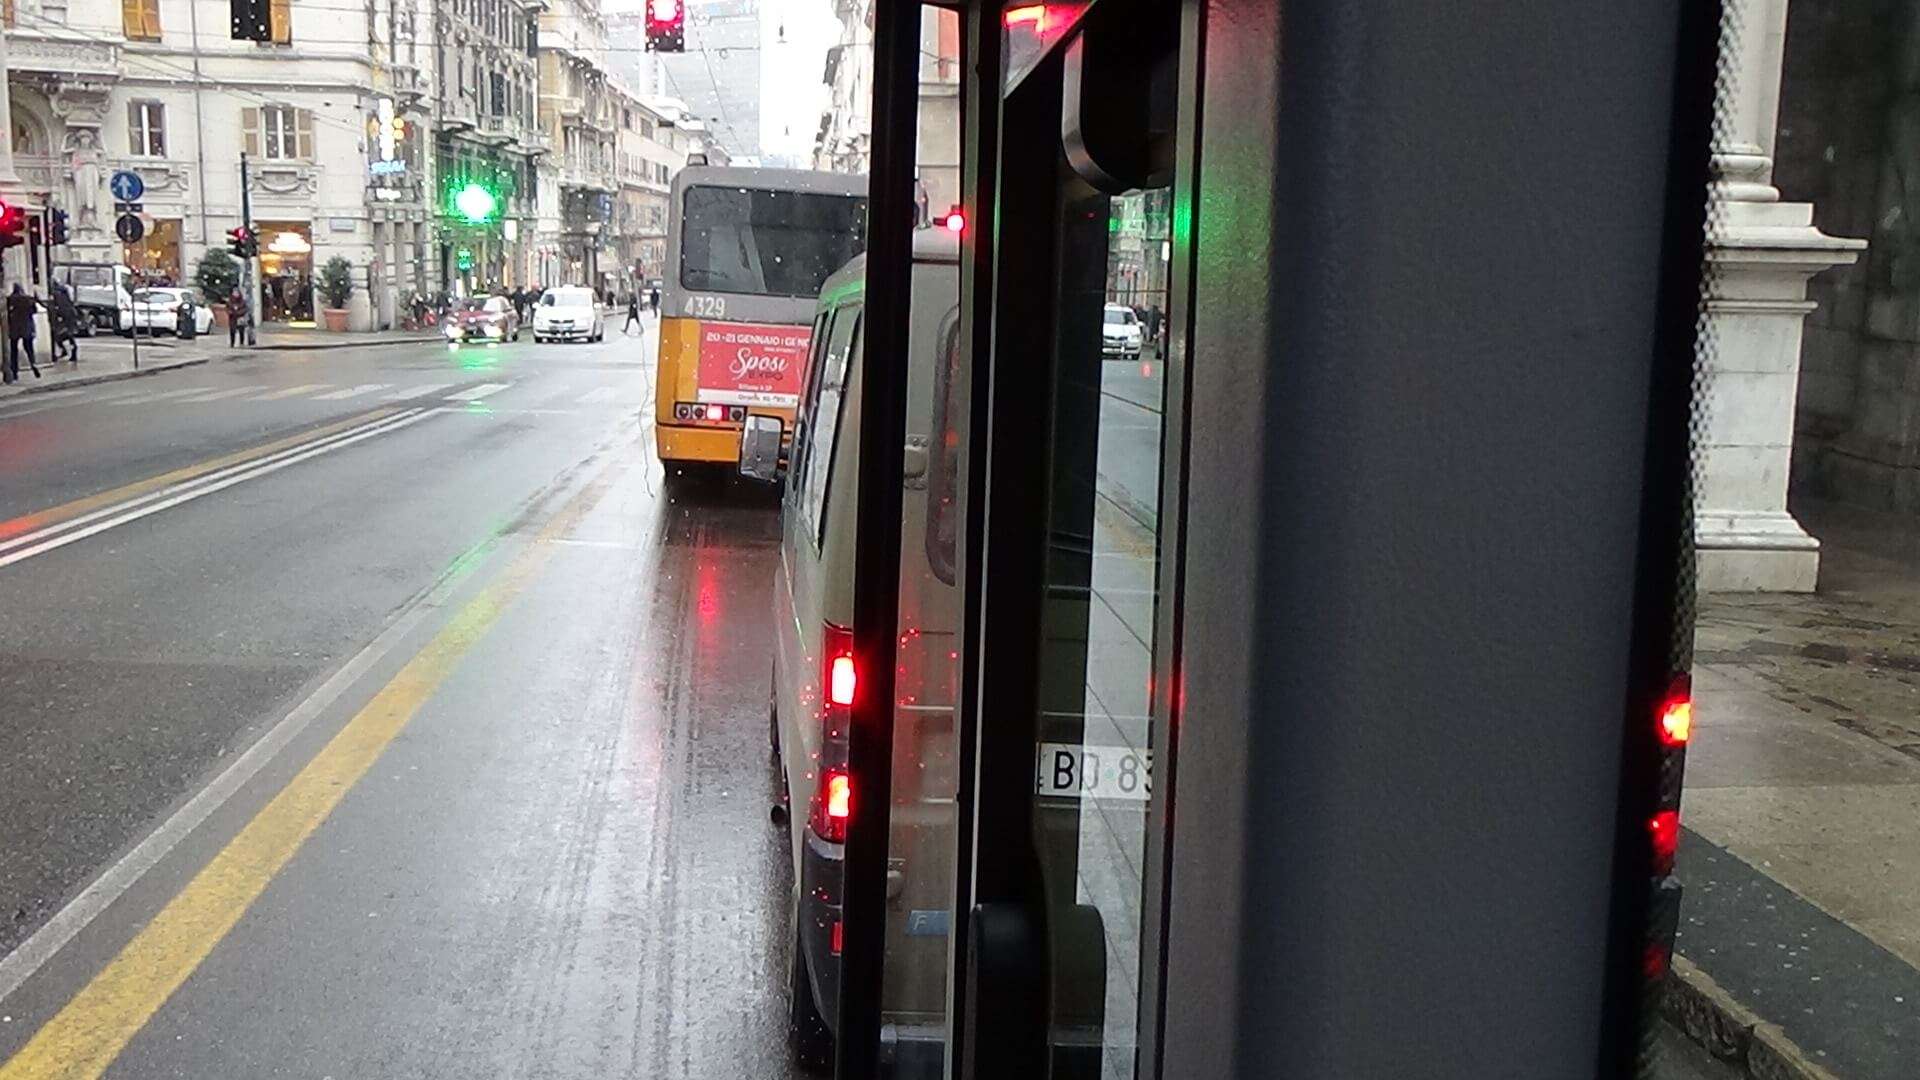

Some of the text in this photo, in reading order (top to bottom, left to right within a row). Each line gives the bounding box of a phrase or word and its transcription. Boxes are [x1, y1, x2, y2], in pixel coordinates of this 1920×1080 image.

[684, 297, 726, 316] 4329
[706, 332, 720, 341] 20
[737, 333, 780, 346] GENNAIO
[729, 347, 788, 380] Sposi
